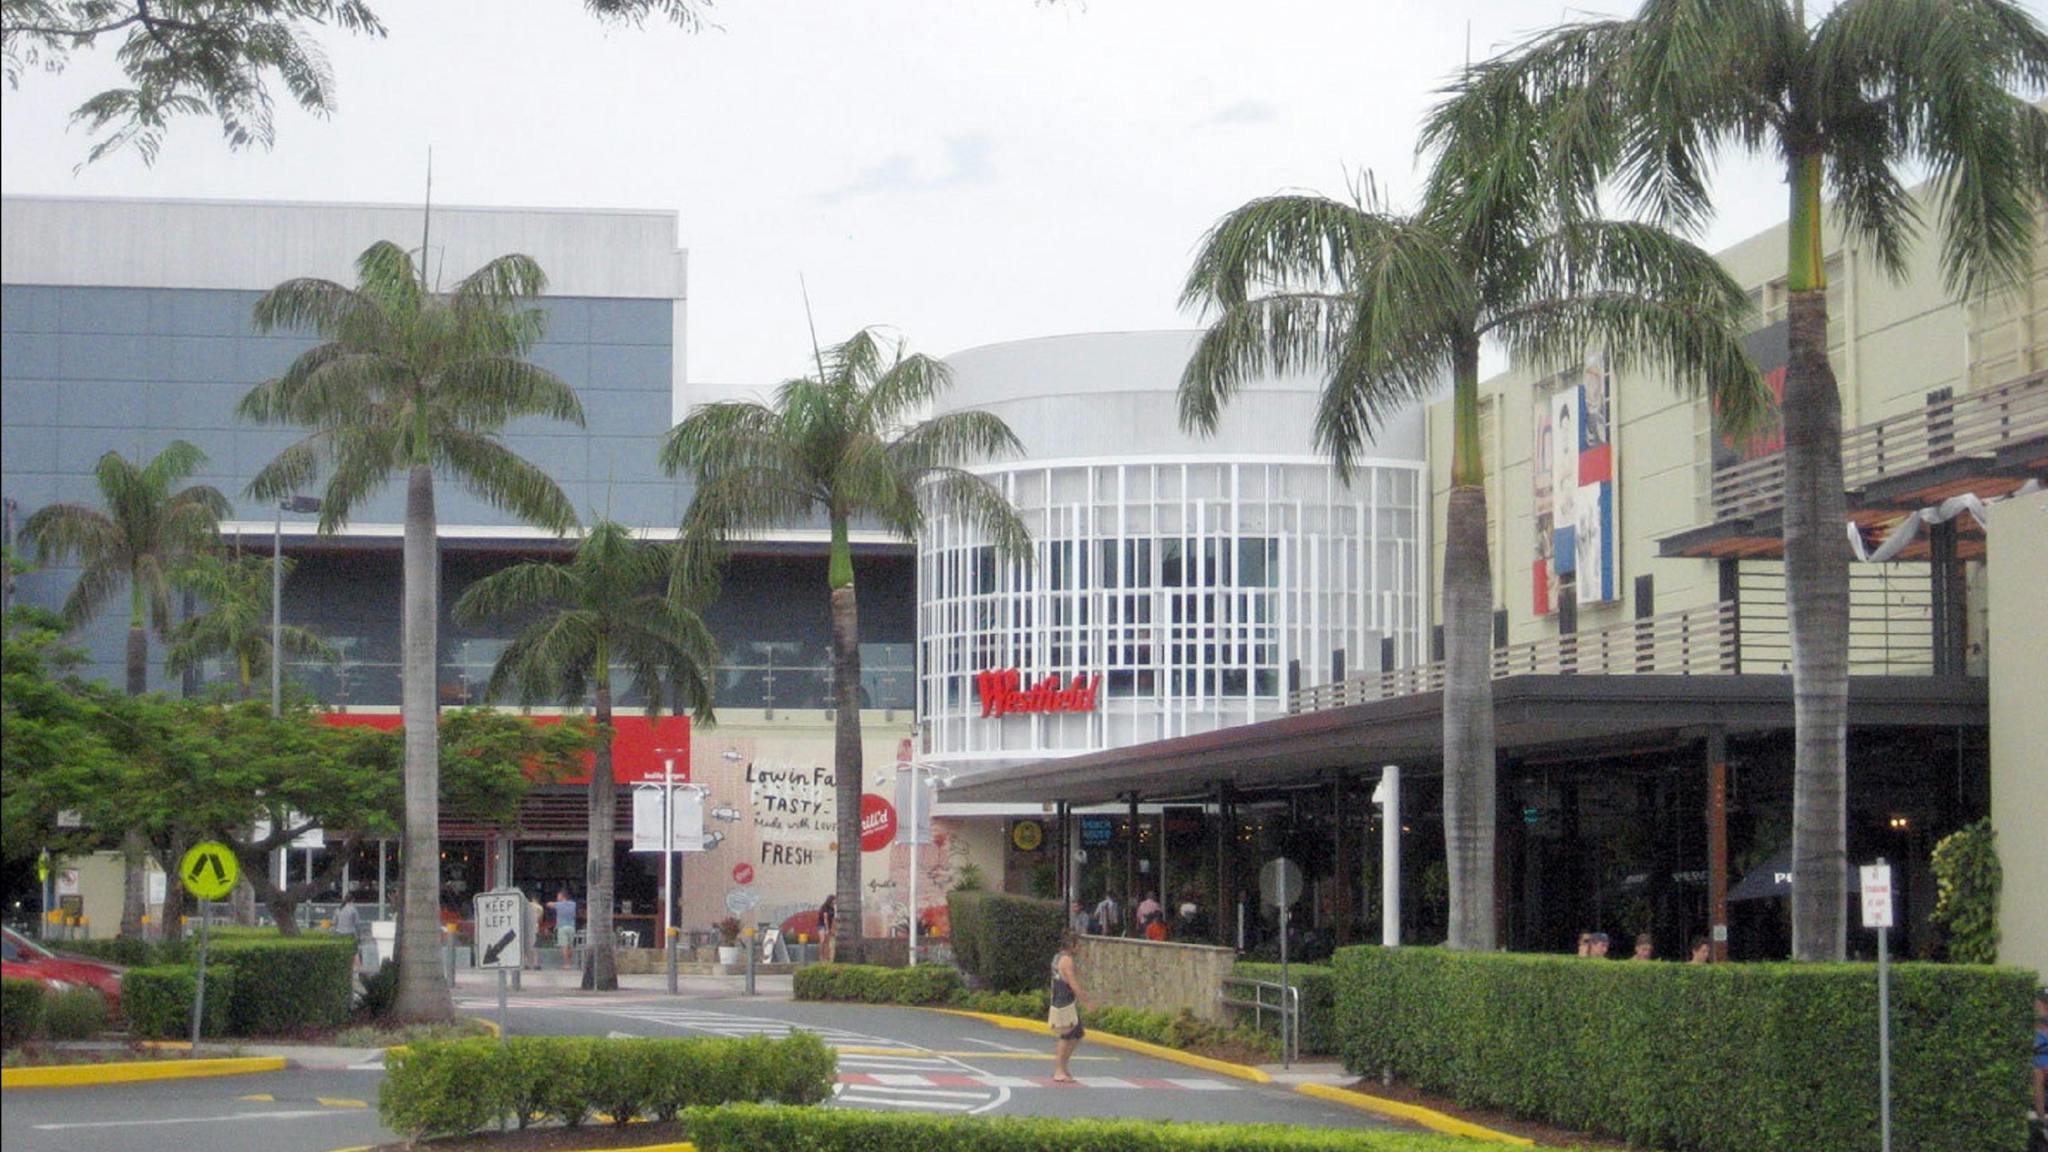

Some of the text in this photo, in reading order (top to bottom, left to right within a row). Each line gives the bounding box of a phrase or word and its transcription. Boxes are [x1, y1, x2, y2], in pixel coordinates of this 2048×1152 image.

[976, 667, 1103, 718] Westfield
[746, 763, 837, 787] Low in Fa
[763, 795, 821, 815] TASTY
[761, 842, 813, 865] FRESH
[485, 900, 514, 912] KEEP
[485, 915, 512, 928] LEFT
